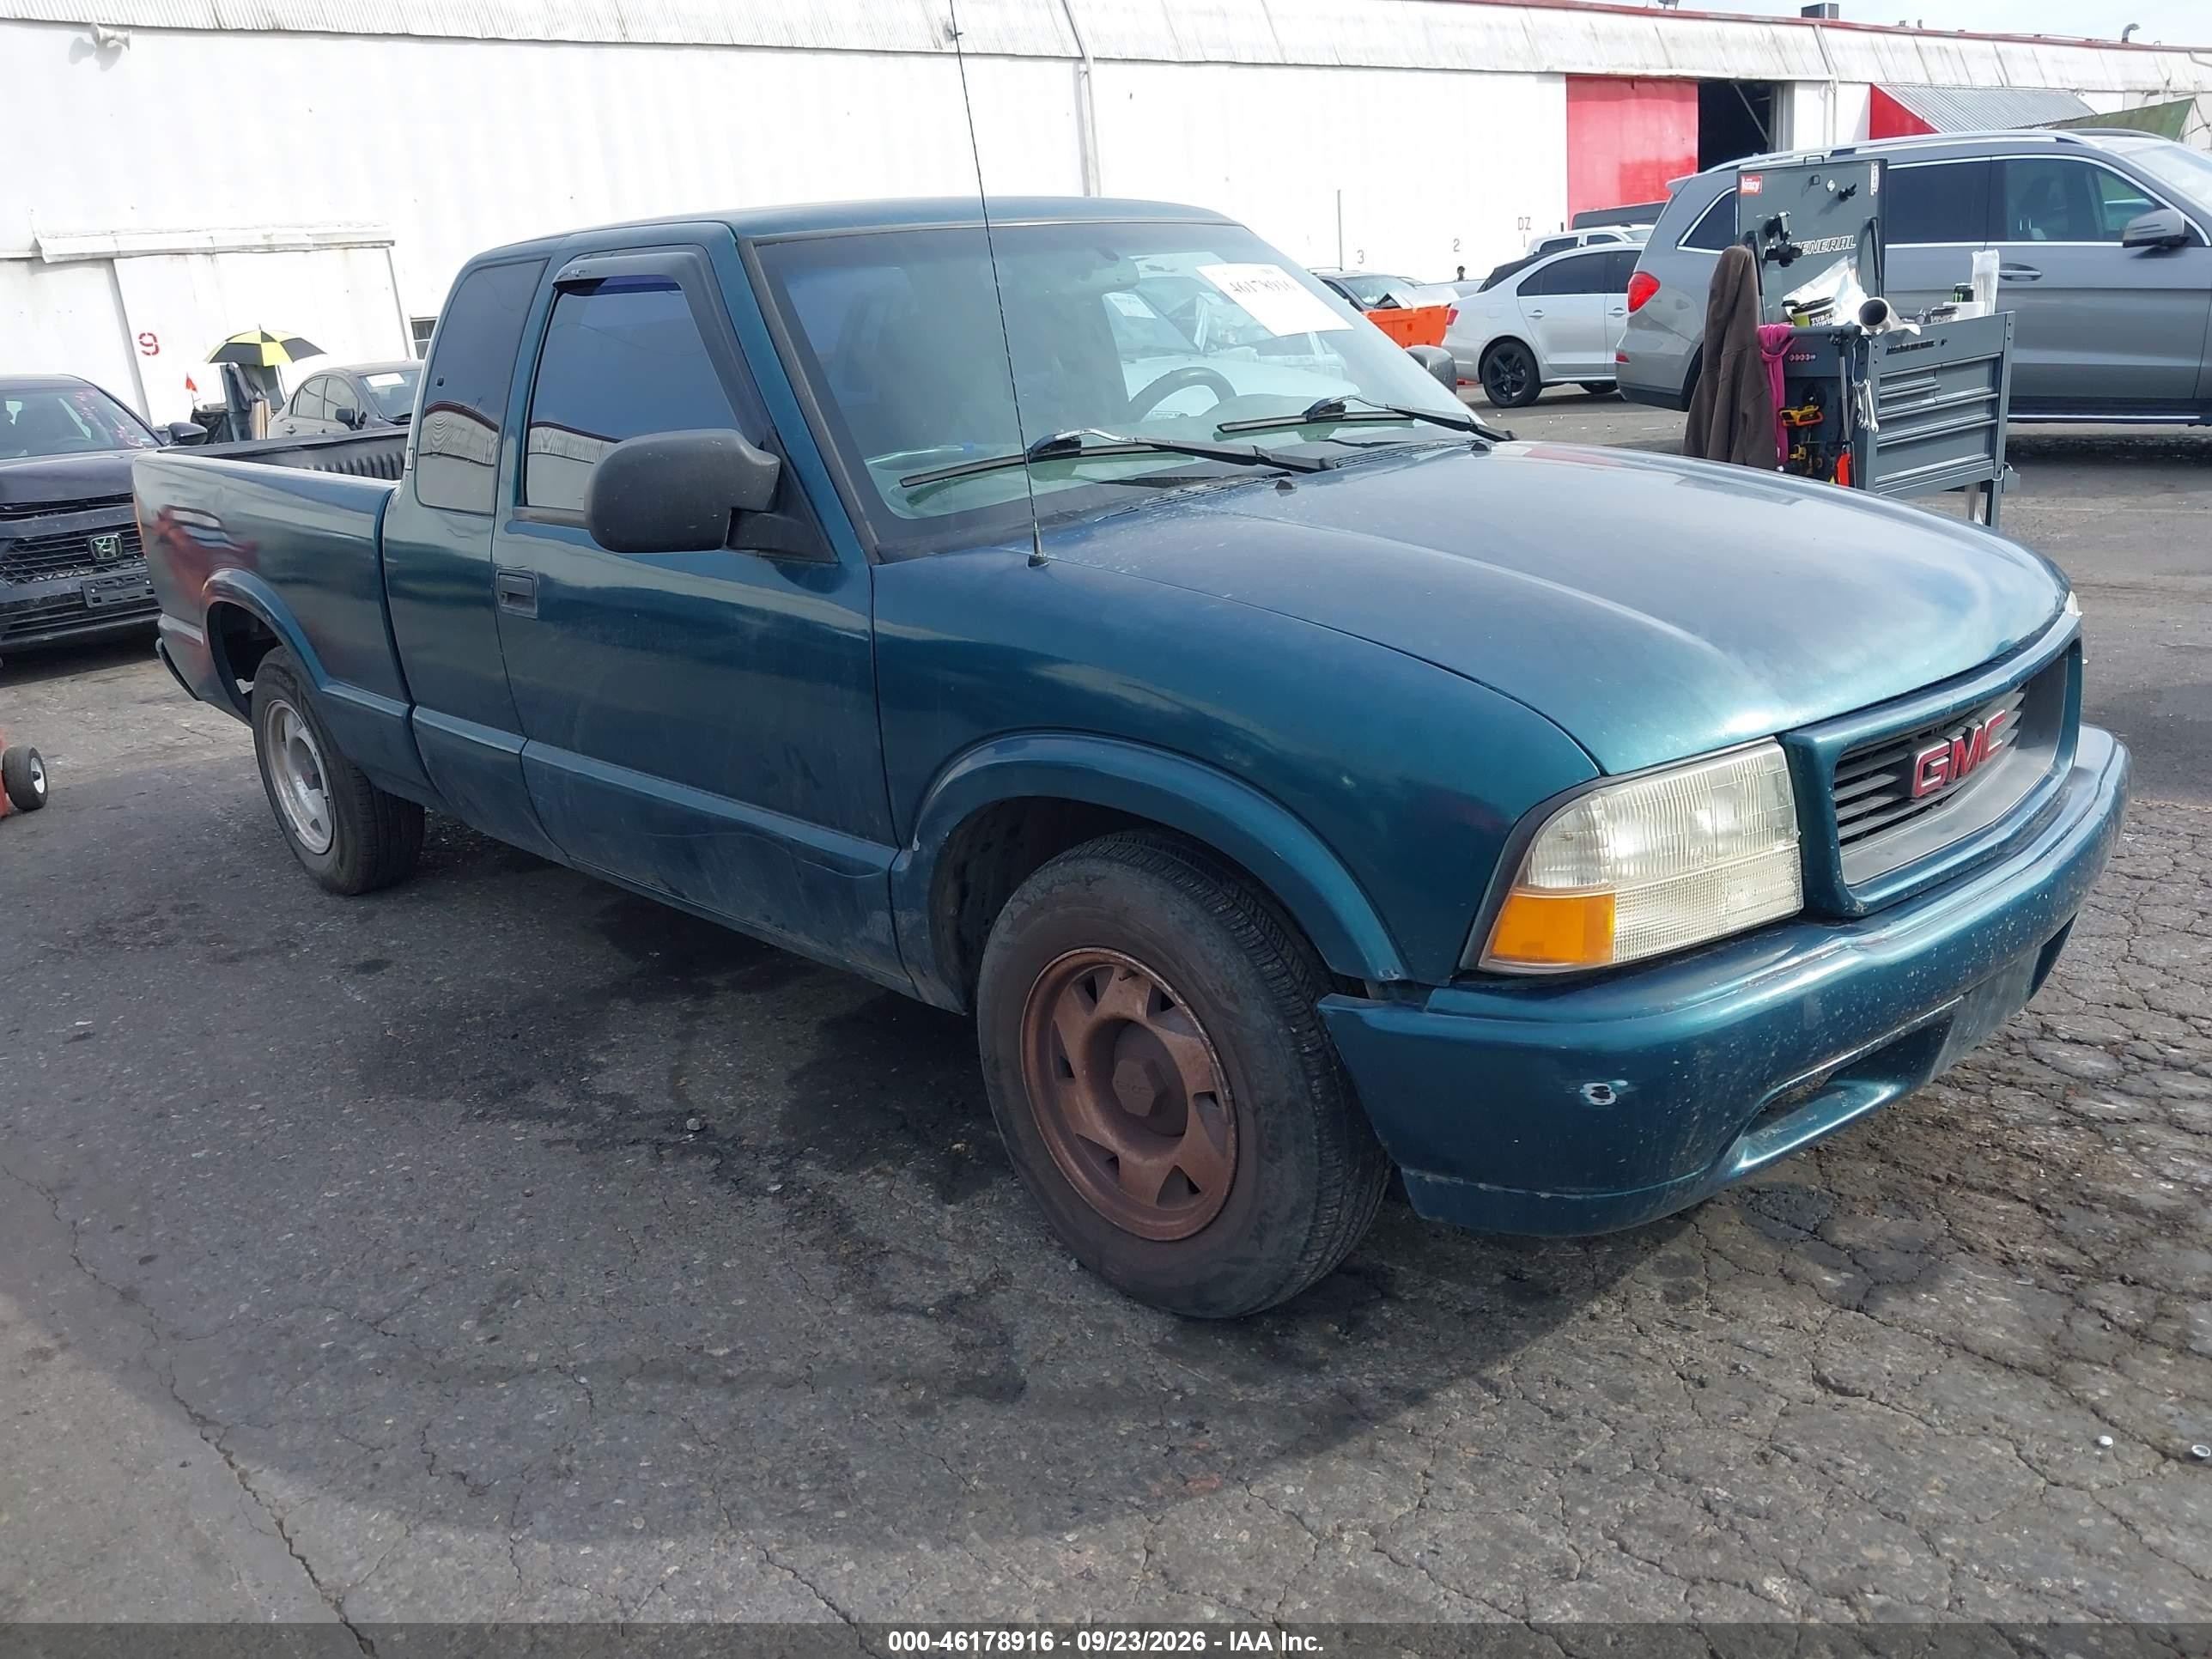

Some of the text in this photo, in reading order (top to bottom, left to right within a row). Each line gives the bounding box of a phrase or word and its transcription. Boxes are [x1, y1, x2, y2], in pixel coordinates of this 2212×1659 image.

[1517, 216, 1532, 231] DZ
[1453, 238, 1461, 252] 2
[1357, 249, 1365, 264] 3
[138, 332, 160, 356] 9
[1911, 708, 2008, 799] GMC
